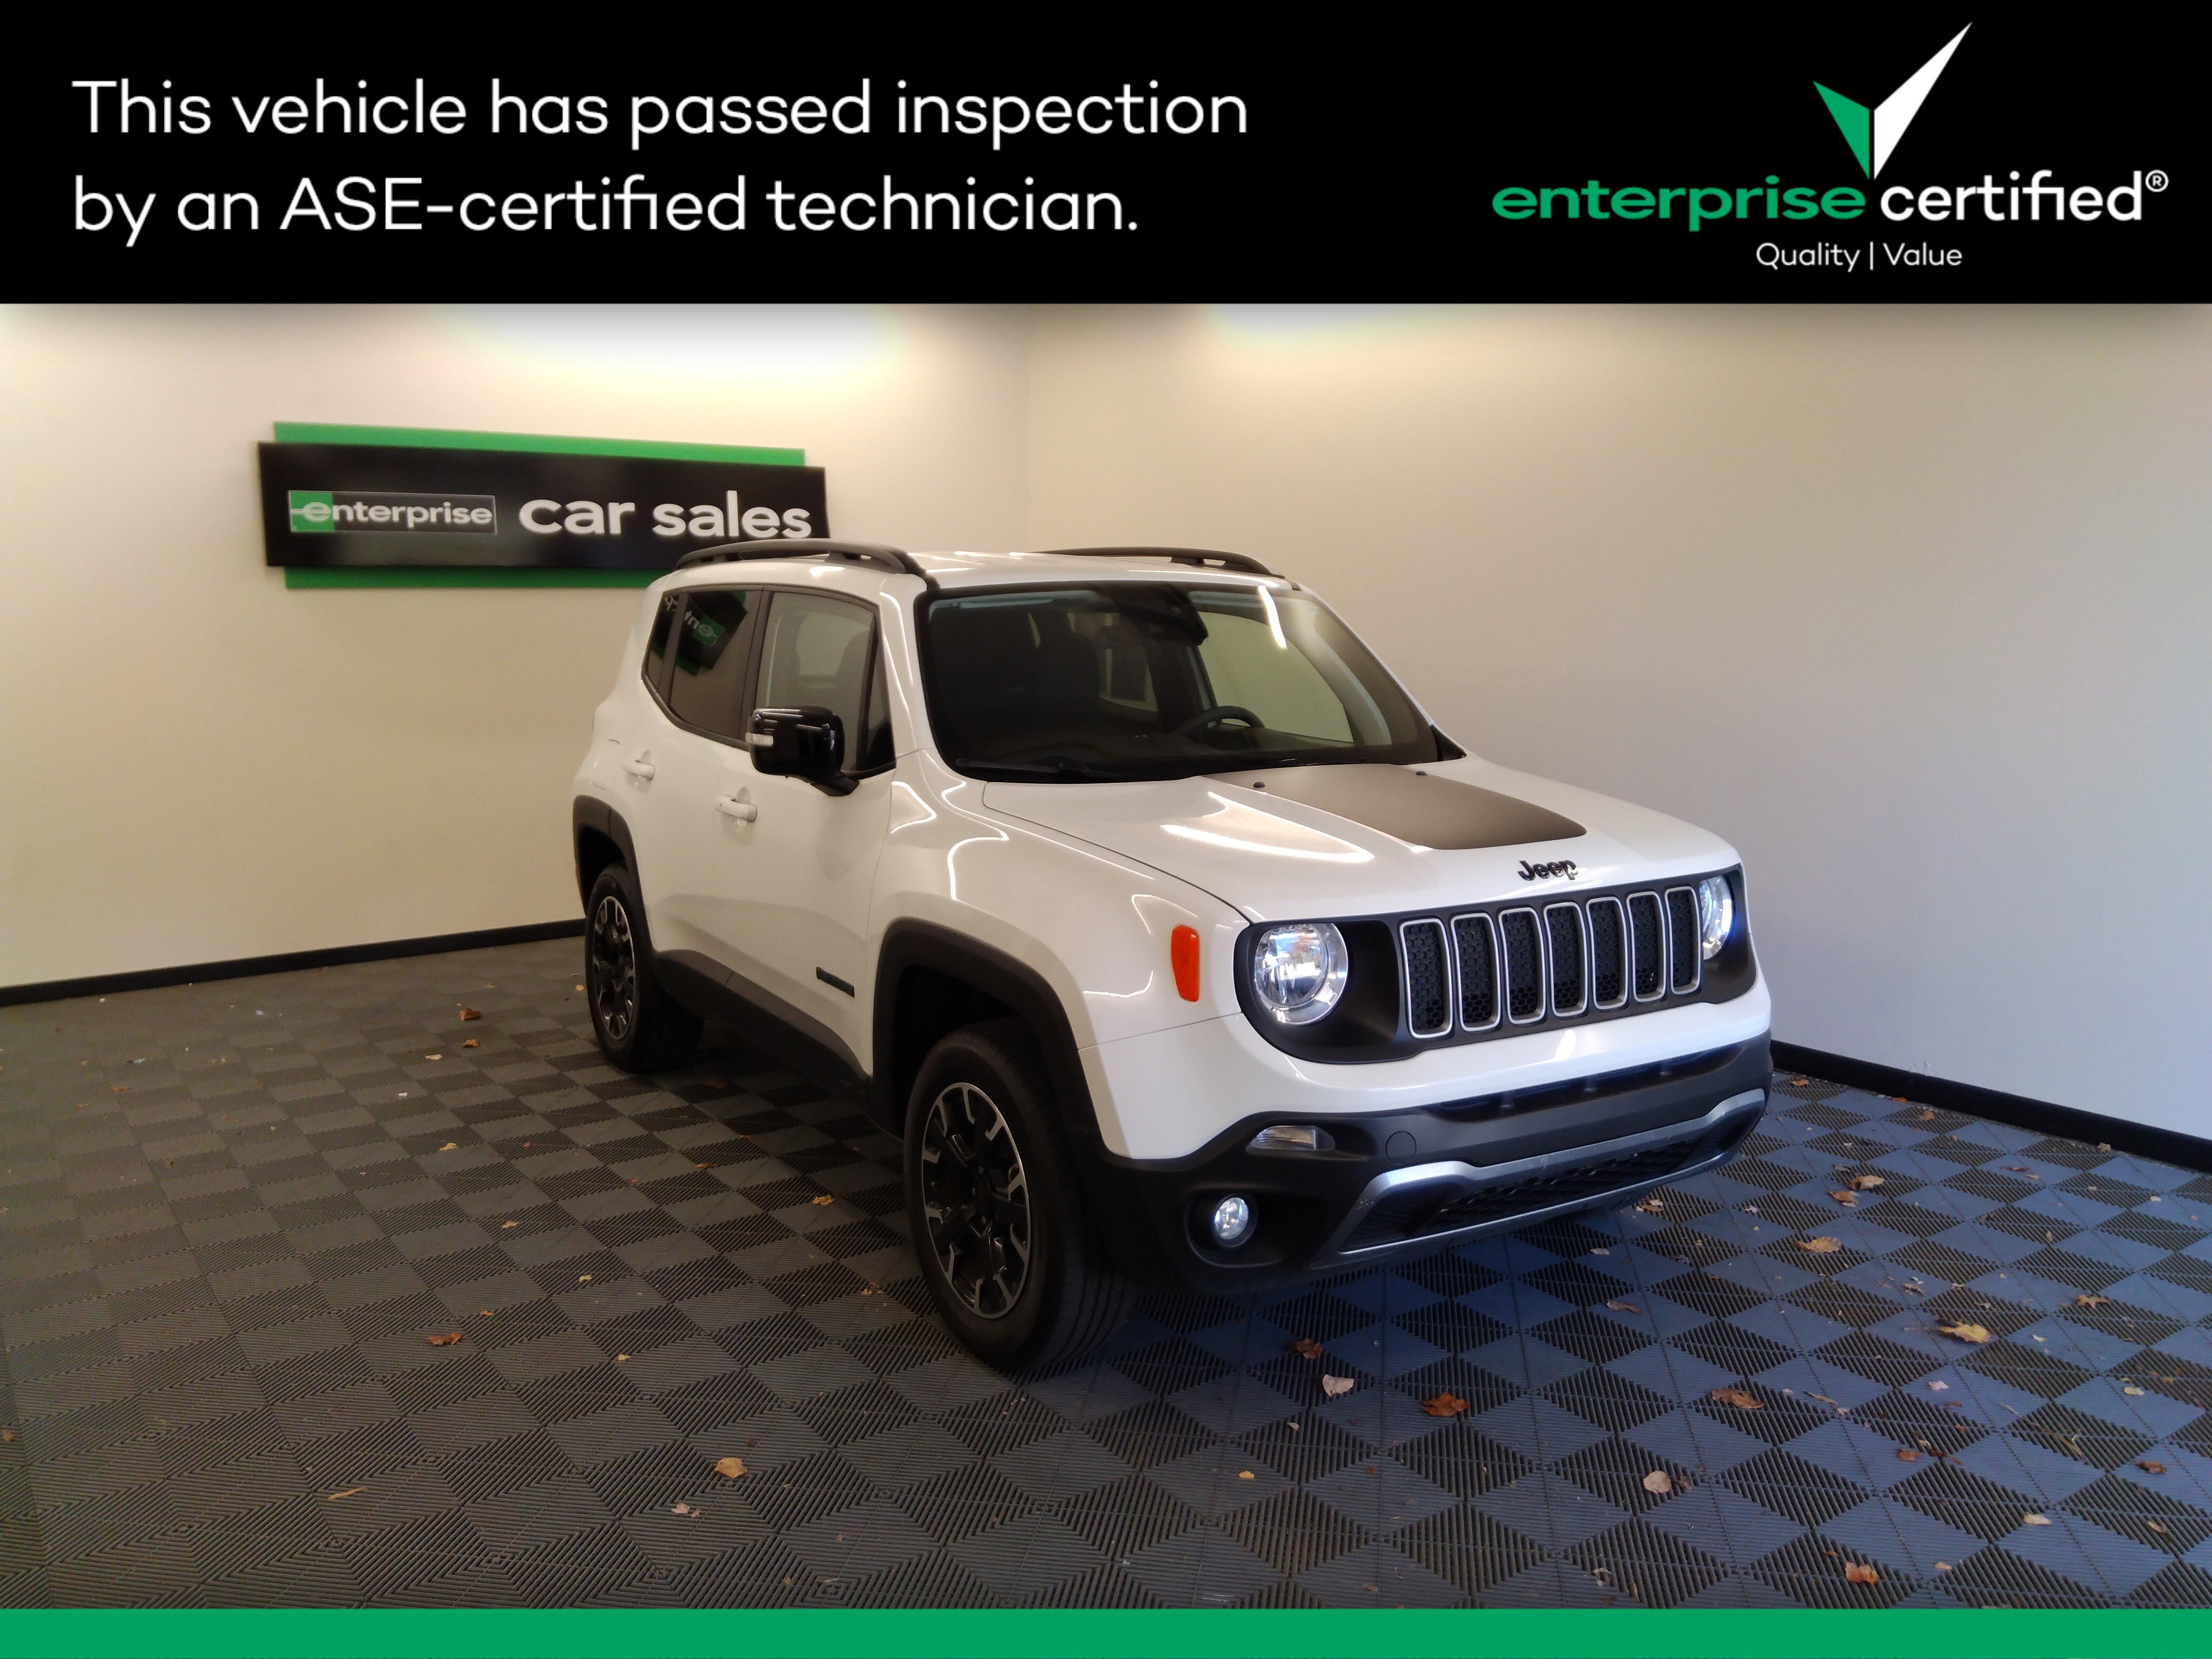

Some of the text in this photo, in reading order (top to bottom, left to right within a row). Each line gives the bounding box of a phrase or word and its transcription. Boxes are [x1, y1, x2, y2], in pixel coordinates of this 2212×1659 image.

[302, 490, 812, 538] enterprise car sales
[1518, 859, 1578, 881] Jeep
